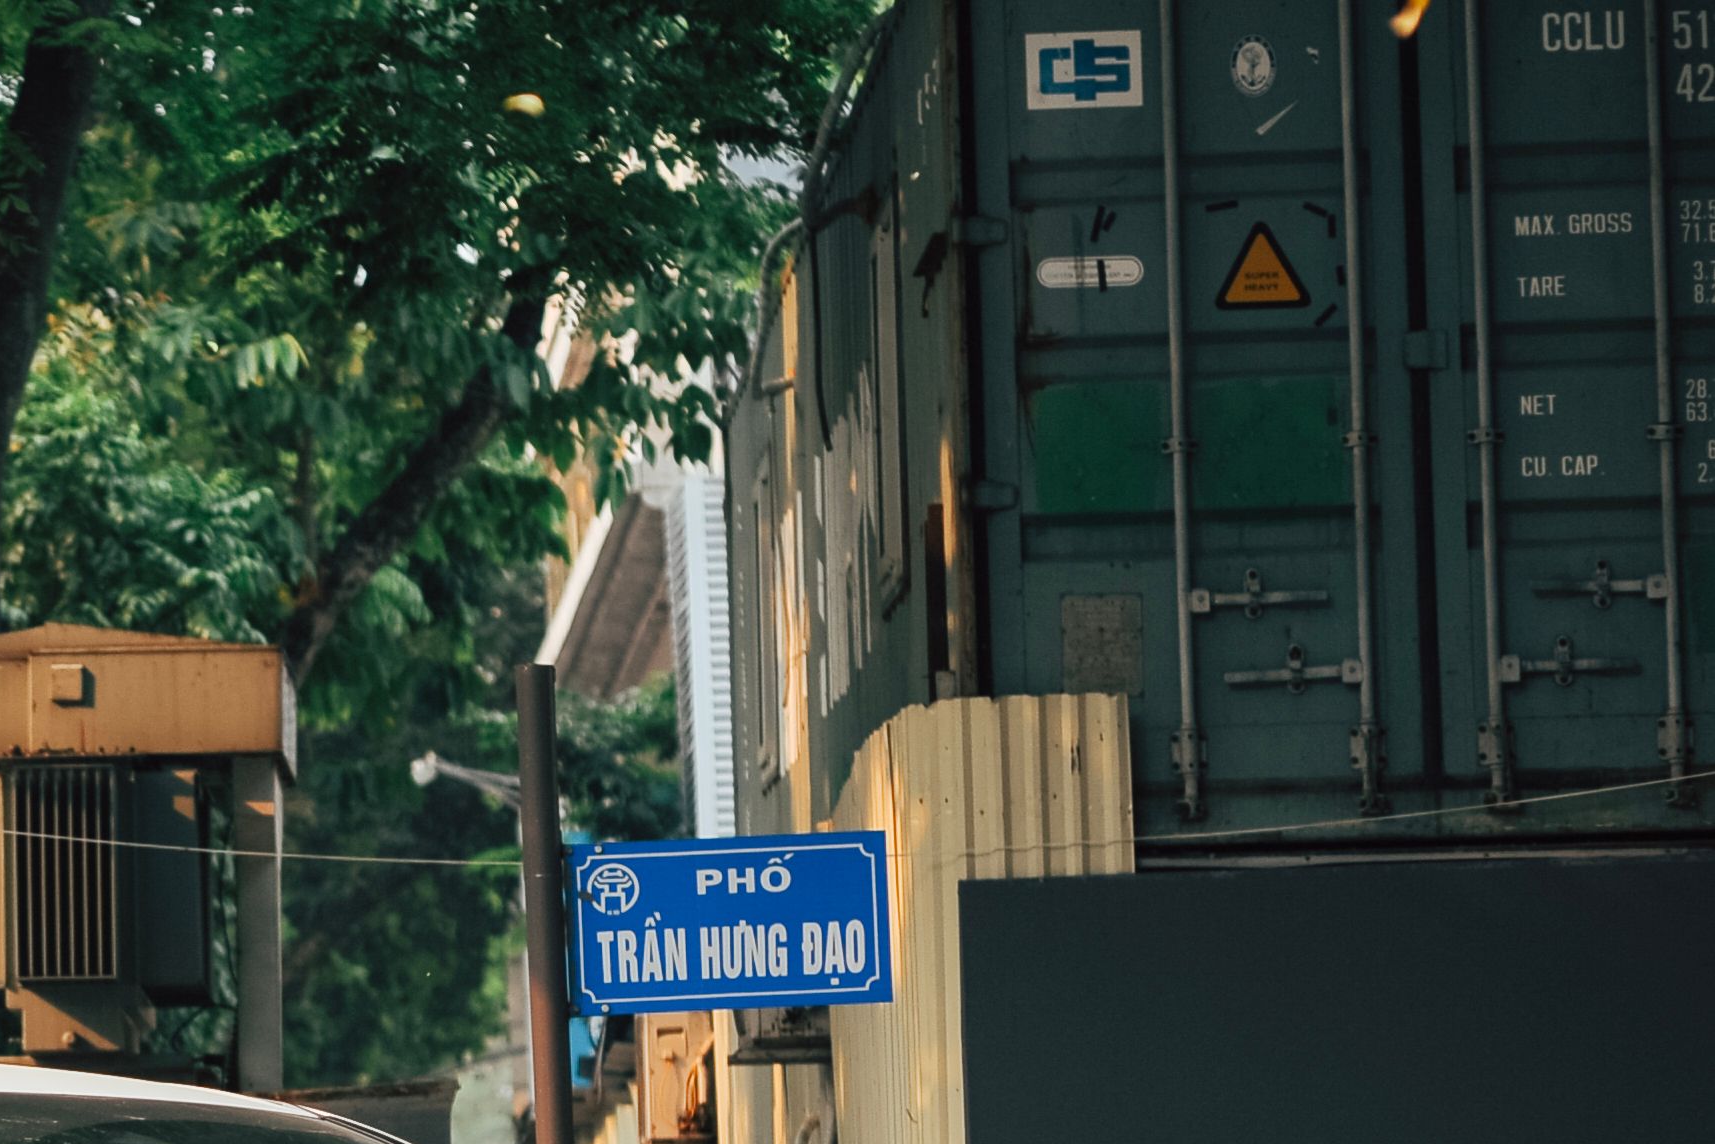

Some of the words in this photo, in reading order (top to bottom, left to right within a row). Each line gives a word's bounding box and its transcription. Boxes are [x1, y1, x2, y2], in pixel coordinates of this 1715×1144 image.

[1542, 10, 1625, 51] CCLU
[1672, 10, 1715, 49] 51
[1568, 212, 1633, 234] GROSS
[1245, 272, 1280, 280] SUPER
[1245, 283, 1279, 291] HEAVY
[1517, 275, 1566, 297] TARE
[1520, 394, 1556, 416] NET
[1561, 455, 1605, 476] CAP.
[696, 853, 795, 895] PHỐ
[597, 912, 688, 983] TRẦN
[699, 920, 788, 980] HƯNG
[801, 919, 867, 985] ĐẠO
